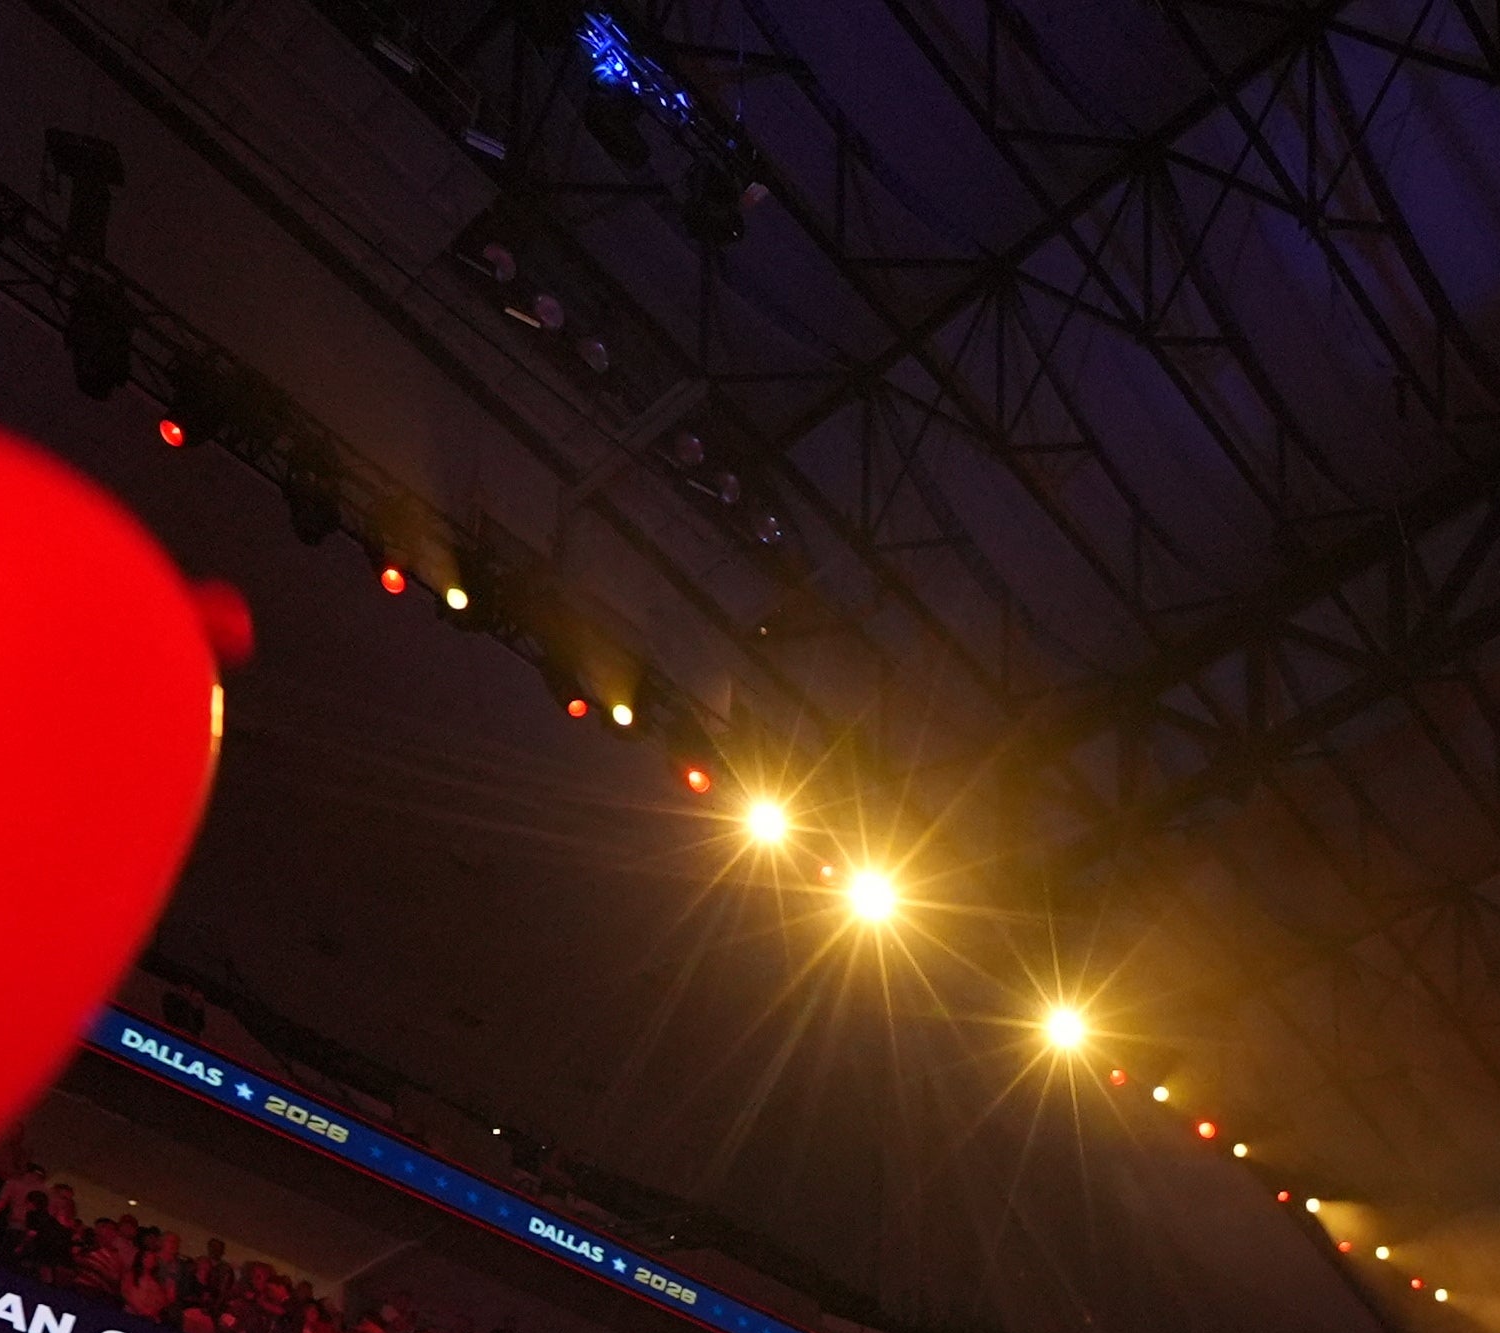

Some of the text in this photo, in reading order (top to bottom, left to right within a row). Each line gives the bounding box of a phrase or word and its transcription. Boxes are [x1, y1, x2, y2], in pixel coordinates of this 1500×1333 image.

[121, 1028, 350, 1143] DALLAS 2026
[529, 1217, 697, 1304] DALLAS 2026
